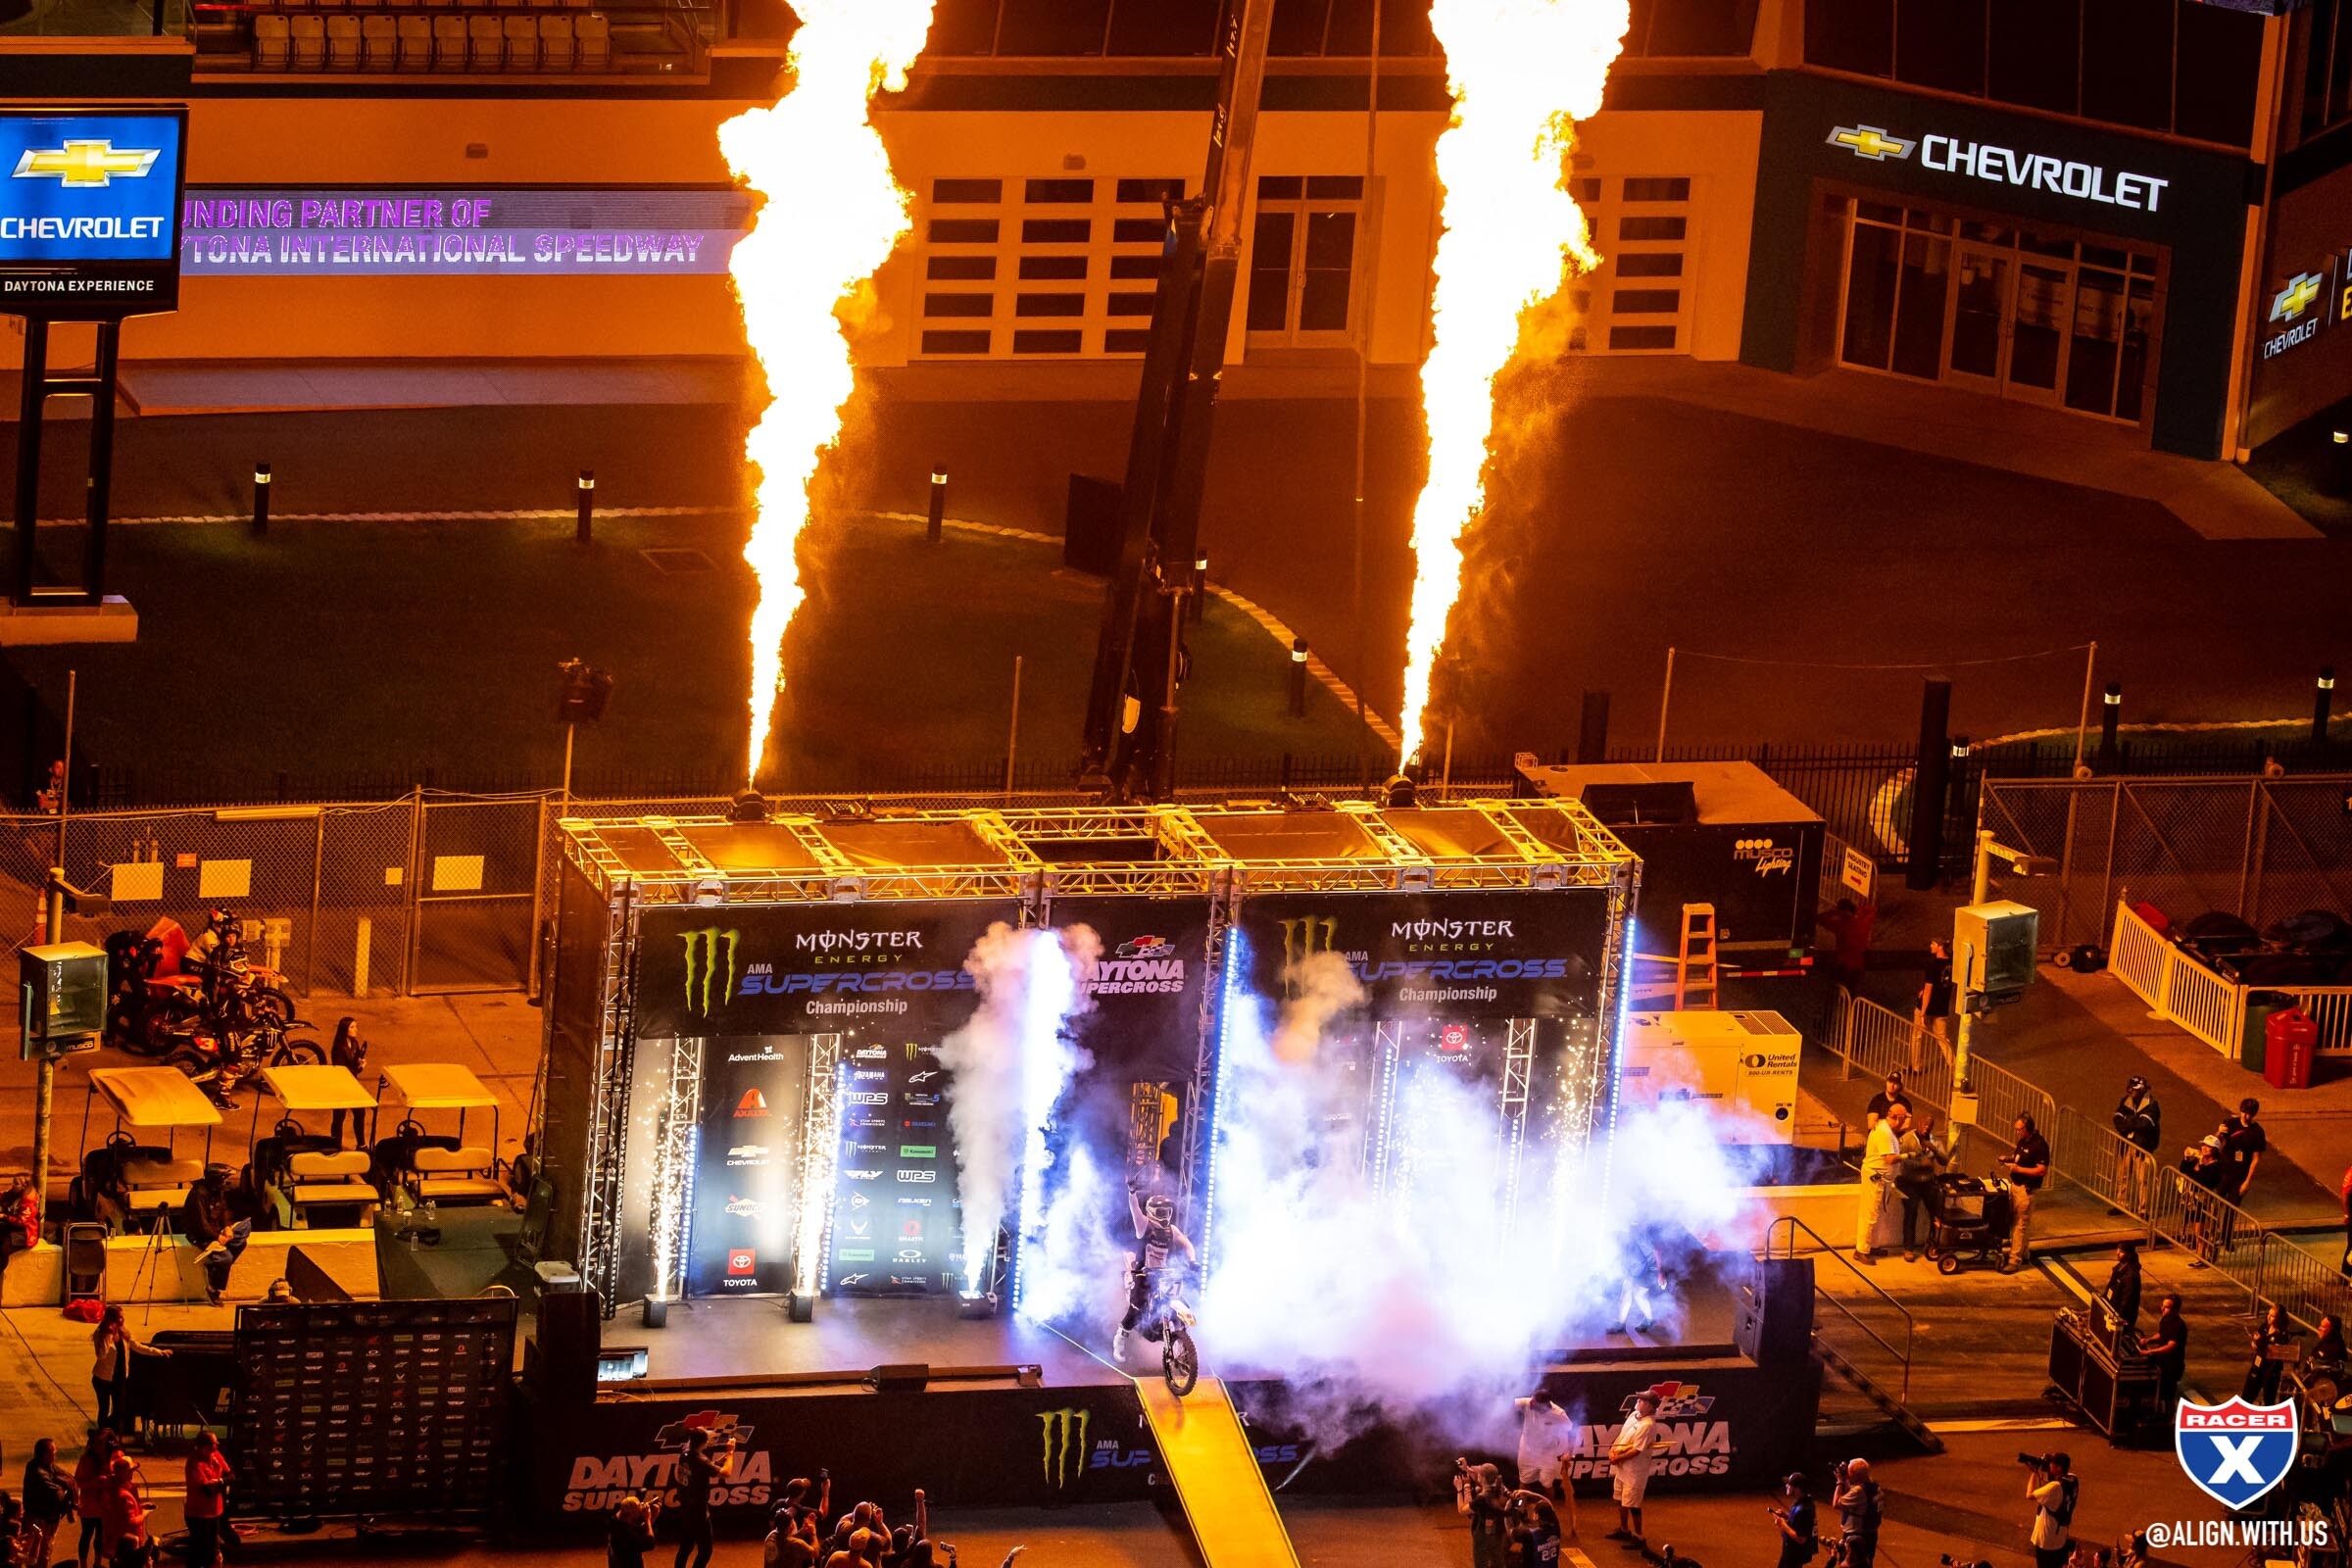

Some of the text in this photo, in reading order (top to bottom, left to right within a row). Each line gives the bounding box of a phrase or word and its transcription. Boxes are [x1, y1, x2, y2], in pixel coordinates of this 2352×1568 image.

[1921, 133, 2169, 212] CHEVROLET
[181, 199, 492, 228] UNDING PARTNER OF
[1, 217, 165, 239] CHEVROLET
[180, 234, 705, 264] TONA INTERNATIONAL SPEEDWAY
[4, 280, 154, 292] DAYTONA EXPERIENCE
[2264, 318, 2319, 360] CHEVROLET
[1754, 857, 1792, 878] Lighting
[1392, 918, 1514, 941] MONSTER
[795, 929, 923, 953] MONSTER
[1408, 943, 1495, 952] ENERGY
[814, 955, 904, 965] ENERGY
[1344, 951, 1368, 962] AMA
[747, 963, 774, 975] AMA
[1090, 959, 1184, 982] AYTONA
[738, 970, 979, 997] SUPERCROSS
[1399, 986, 1497, 1004] Championship
[806, 999, 908, 1015] Championship
[728, 1053, 784, 1062] AdventHealth
[1436, 1054, 1469, 1063] TOYOTA
[850, 1092, 889, 1105] WPS
[897, 1169, 936, 1183] WPS
[723, 1278, 758, 1287] TOYOTA
[1097, 1440, 1119, 1450] AMA
[567, 1450, 772, 1490] DAYTNA
